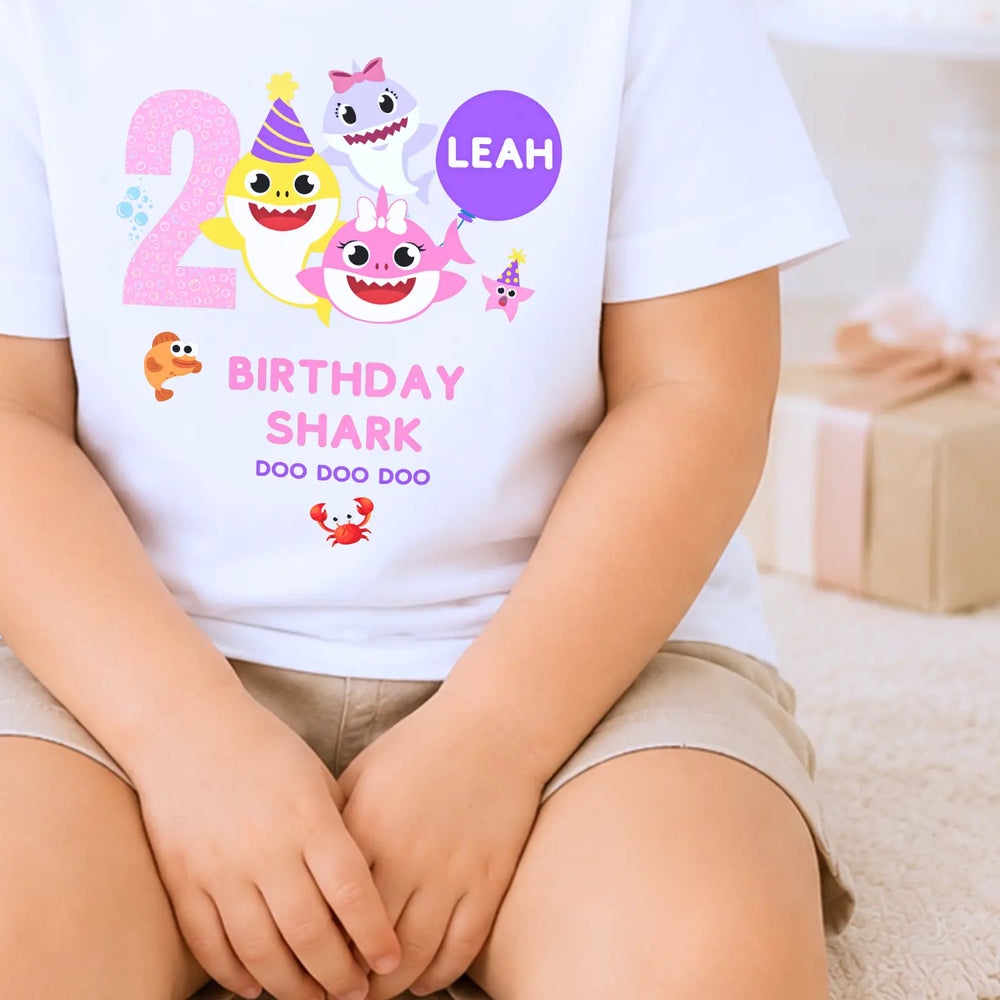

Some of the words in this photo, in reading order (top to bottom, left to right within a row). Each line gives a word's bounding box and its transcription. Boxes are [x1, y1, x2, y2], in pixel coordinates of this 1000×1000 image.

[448, 136, 554, 170] LEAH
[123, 89, 241, 309] 2
[228, 356, 465, 401] BIRTHDAY
[266, 411, 422, 453] SHARK
[255, 460, 308, 480] DOO
[317, 464, 369, 484] DOO
[378, 467, 431, 486] DOO
